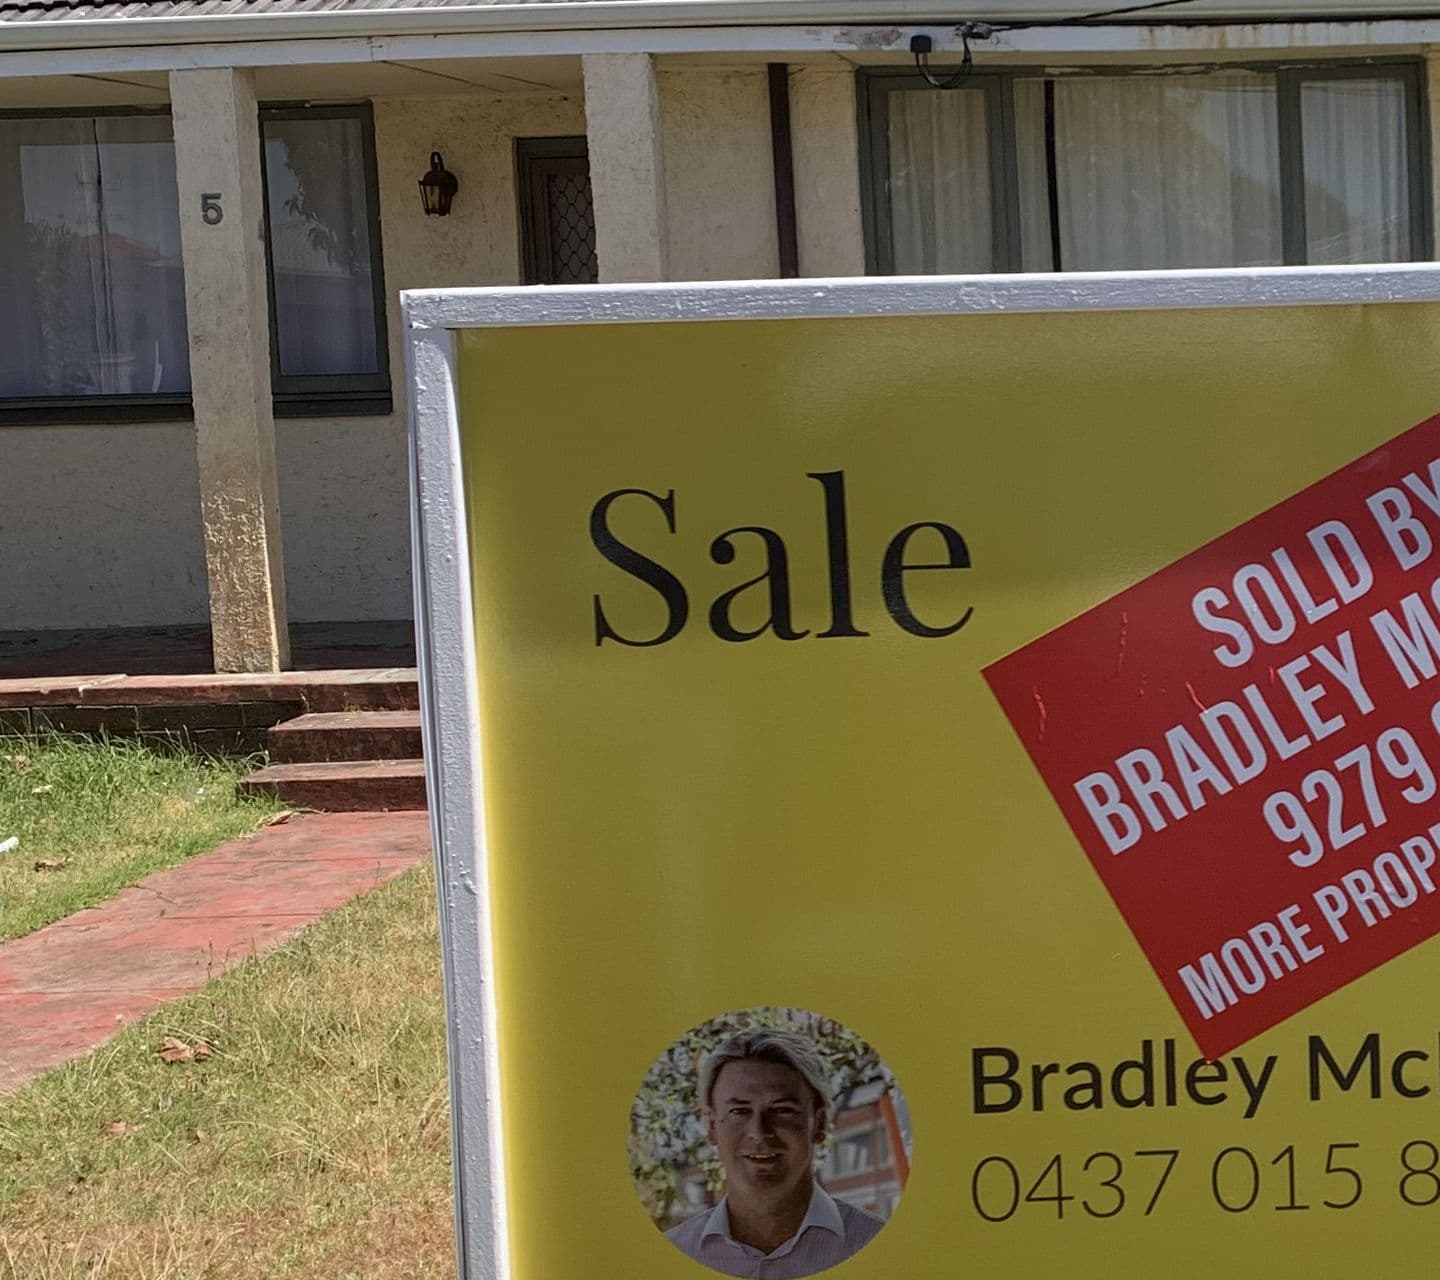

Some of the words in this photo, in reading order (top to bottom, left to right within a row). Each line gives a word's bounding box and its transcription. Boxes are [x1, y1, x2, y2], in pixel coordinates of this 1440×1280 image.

[200, 192, 224, 226] 5
[589, 469, 974, 648] Sale
[1192, 521, 1373, 667] SOLD
[1074, 631, 1374, 855] BRADLEY
[1263, 728, 1436, 867] 9279
[1178, 904, 1324, 1019] MORE
[971, 1039, 1278, 1119] Bradley
[971, 1150, 1180, 1223] 0437
[1211, 1143, 1363, 1214] 015
